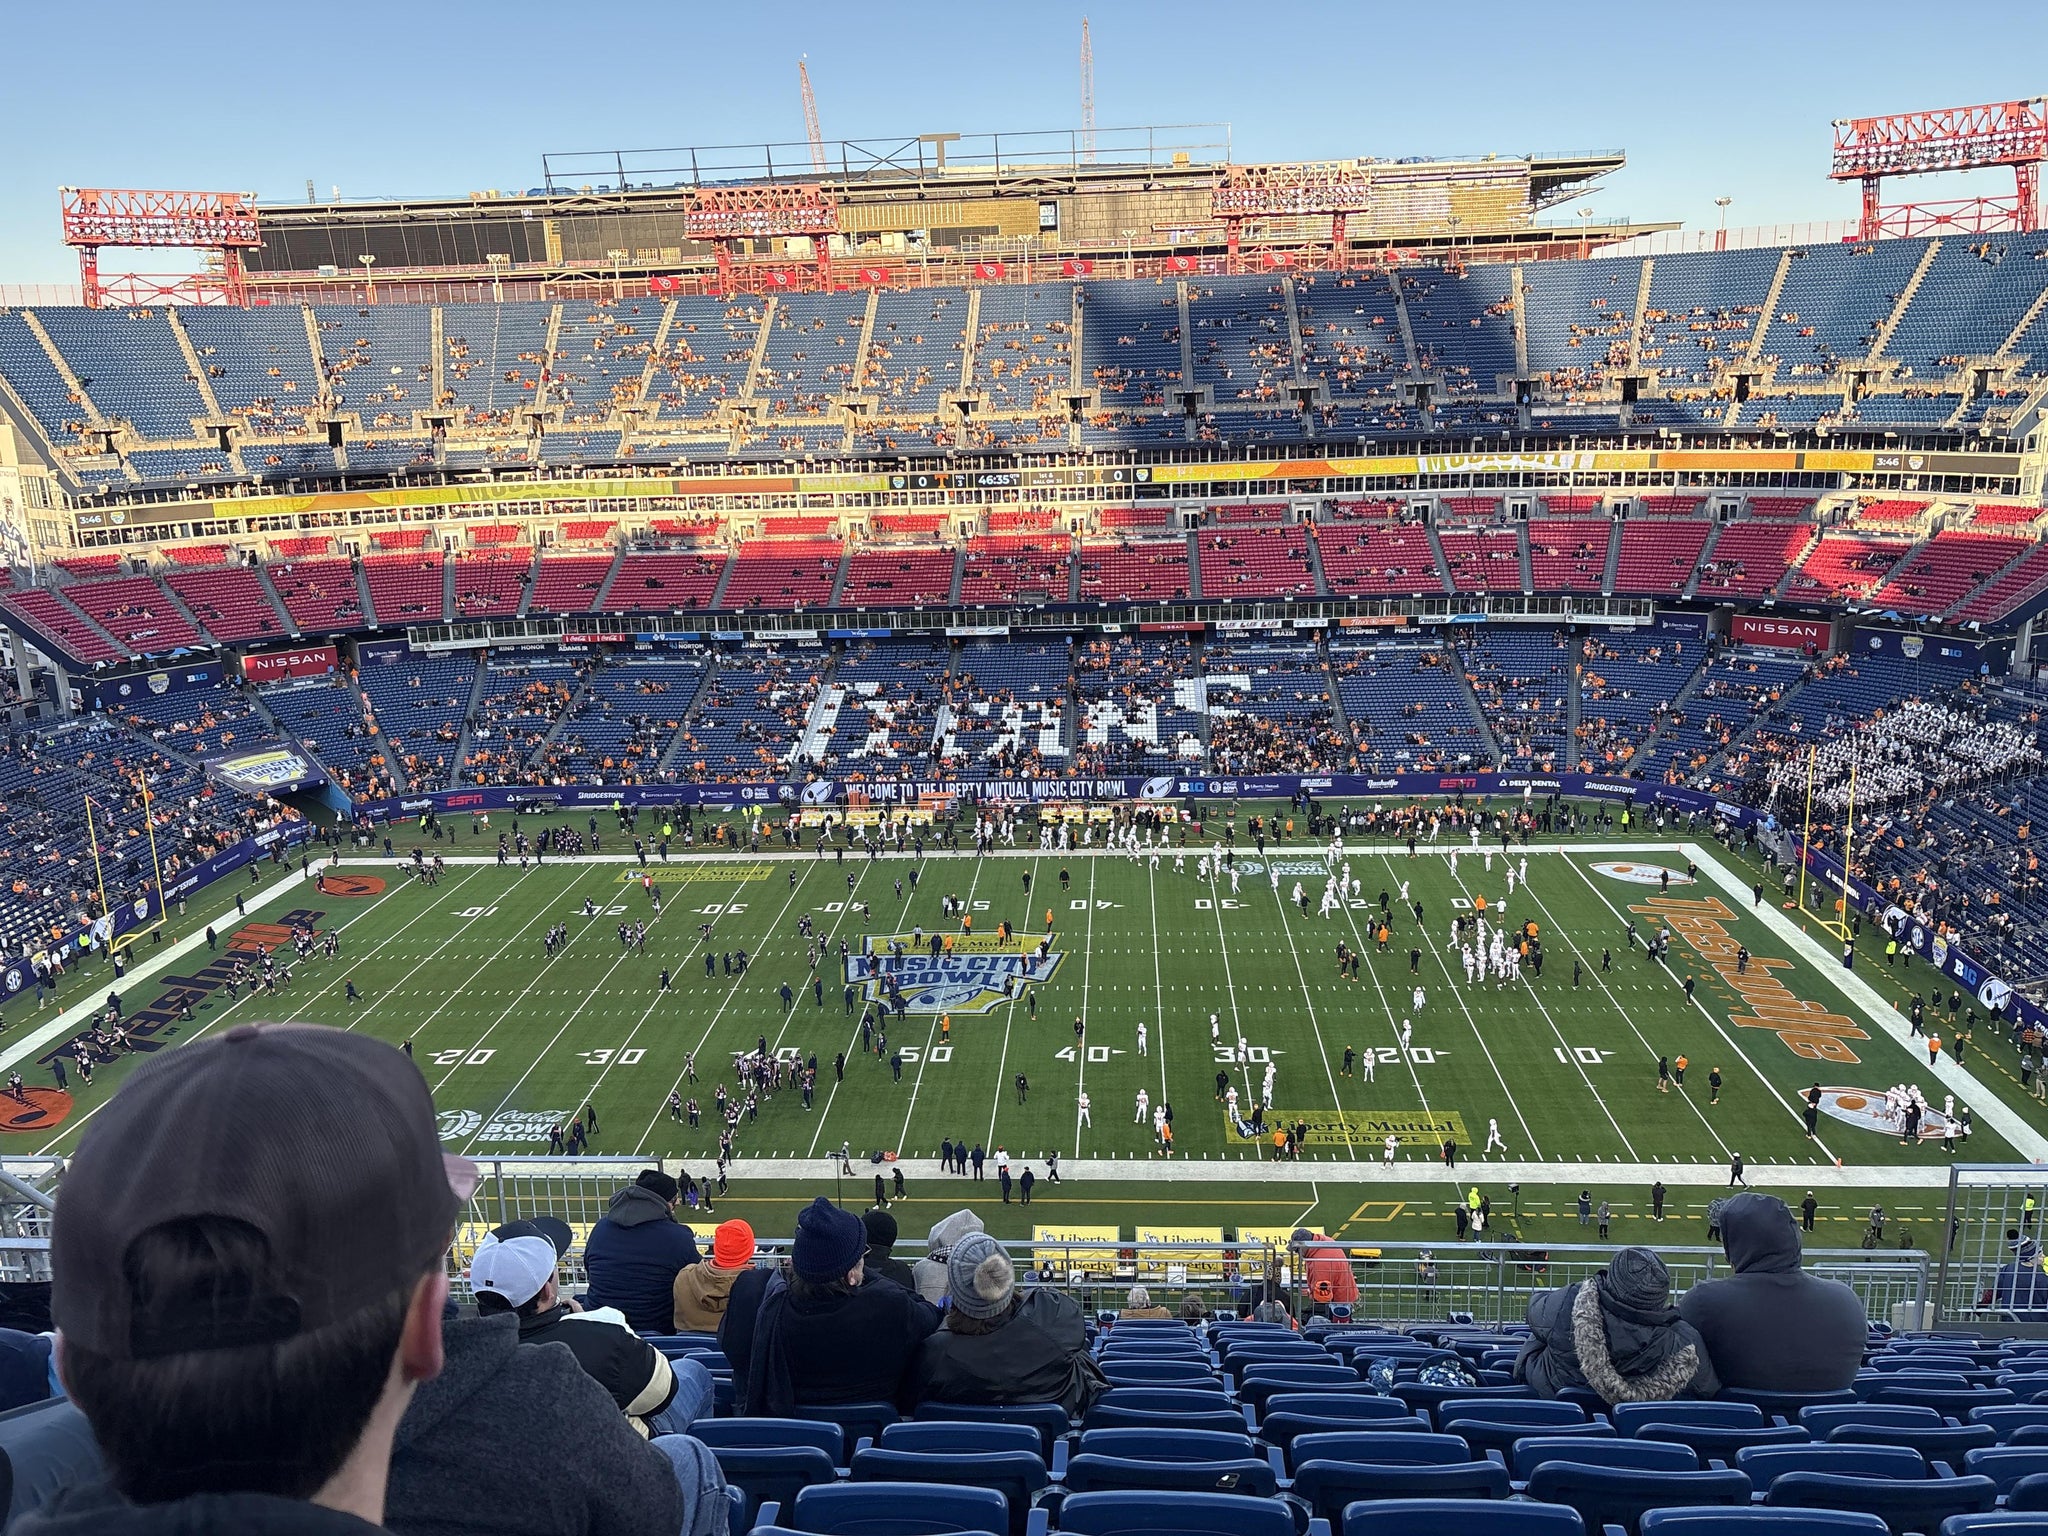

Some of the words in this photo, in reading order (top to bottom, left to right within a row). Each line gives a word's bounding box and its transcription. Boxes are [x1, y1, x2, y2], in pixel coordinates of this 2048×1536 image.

[1876, 457, 1899, 467] 3:46
[918, 476, 927, 487] 0
[978, 475, 1010, 486] 46:35
[1113, 470, 1123, 481] 0
[80, 515, 102, 525] 3:46
[1744, 622, 1818, 637] NISSAN
[257, 653, 326, 670] NISSAN
[229, 762, 269, 778] MUSIC
[269, 759, 299, 768] CITY
[846, 783, 898, 800] WELCOME
[901, 783, 913, 799] TO
[916, 783, 936, 796] THE
[939, 783, 982, 798] LIBERTY
[985, 782, 1028, 798] MUTUAL
[1032, 781, 1066, 797] MUSIC
[1069, 781, 1095, 796] CITY
[1097, 780, 1128, 796] BOWL
[1439, 778, 1477, 788] ESPN
[1584, 781, 1637, 794] BRIDGESTONE
[578, 791, 625, 799] BRIDGESTONE
[779, 786, 793, 798] SEC
[447, 794, 483, 807] ESPN
[855, 957, 964, 977] MUSIC
[967, 957, 1050, 976] CITY
[7, 972, 22, 989] SEC
[36, 908, 327, 1065] Nashville
[895, 971, 1000, 987] BOWL
[1626, 896, 1871, 1064] Nashville
[433, 1049, 498, 1065] 20
[585, 1049, 648, 1065] 30
[898, 1046, 955, 1062] 50
[1055, 1046, 1110, 1062] 40
[1213, 1046, 1270, 1062] 30
[1374, 1047, 1436, 1064] 20
[1552, 1047, 1604, 1064] 10
[1273, 1119, 1358, 1135] Liberty
[1366, 1119, 1456, 1133] Mutual
[476, 1133, 553, 1142] SEASON
